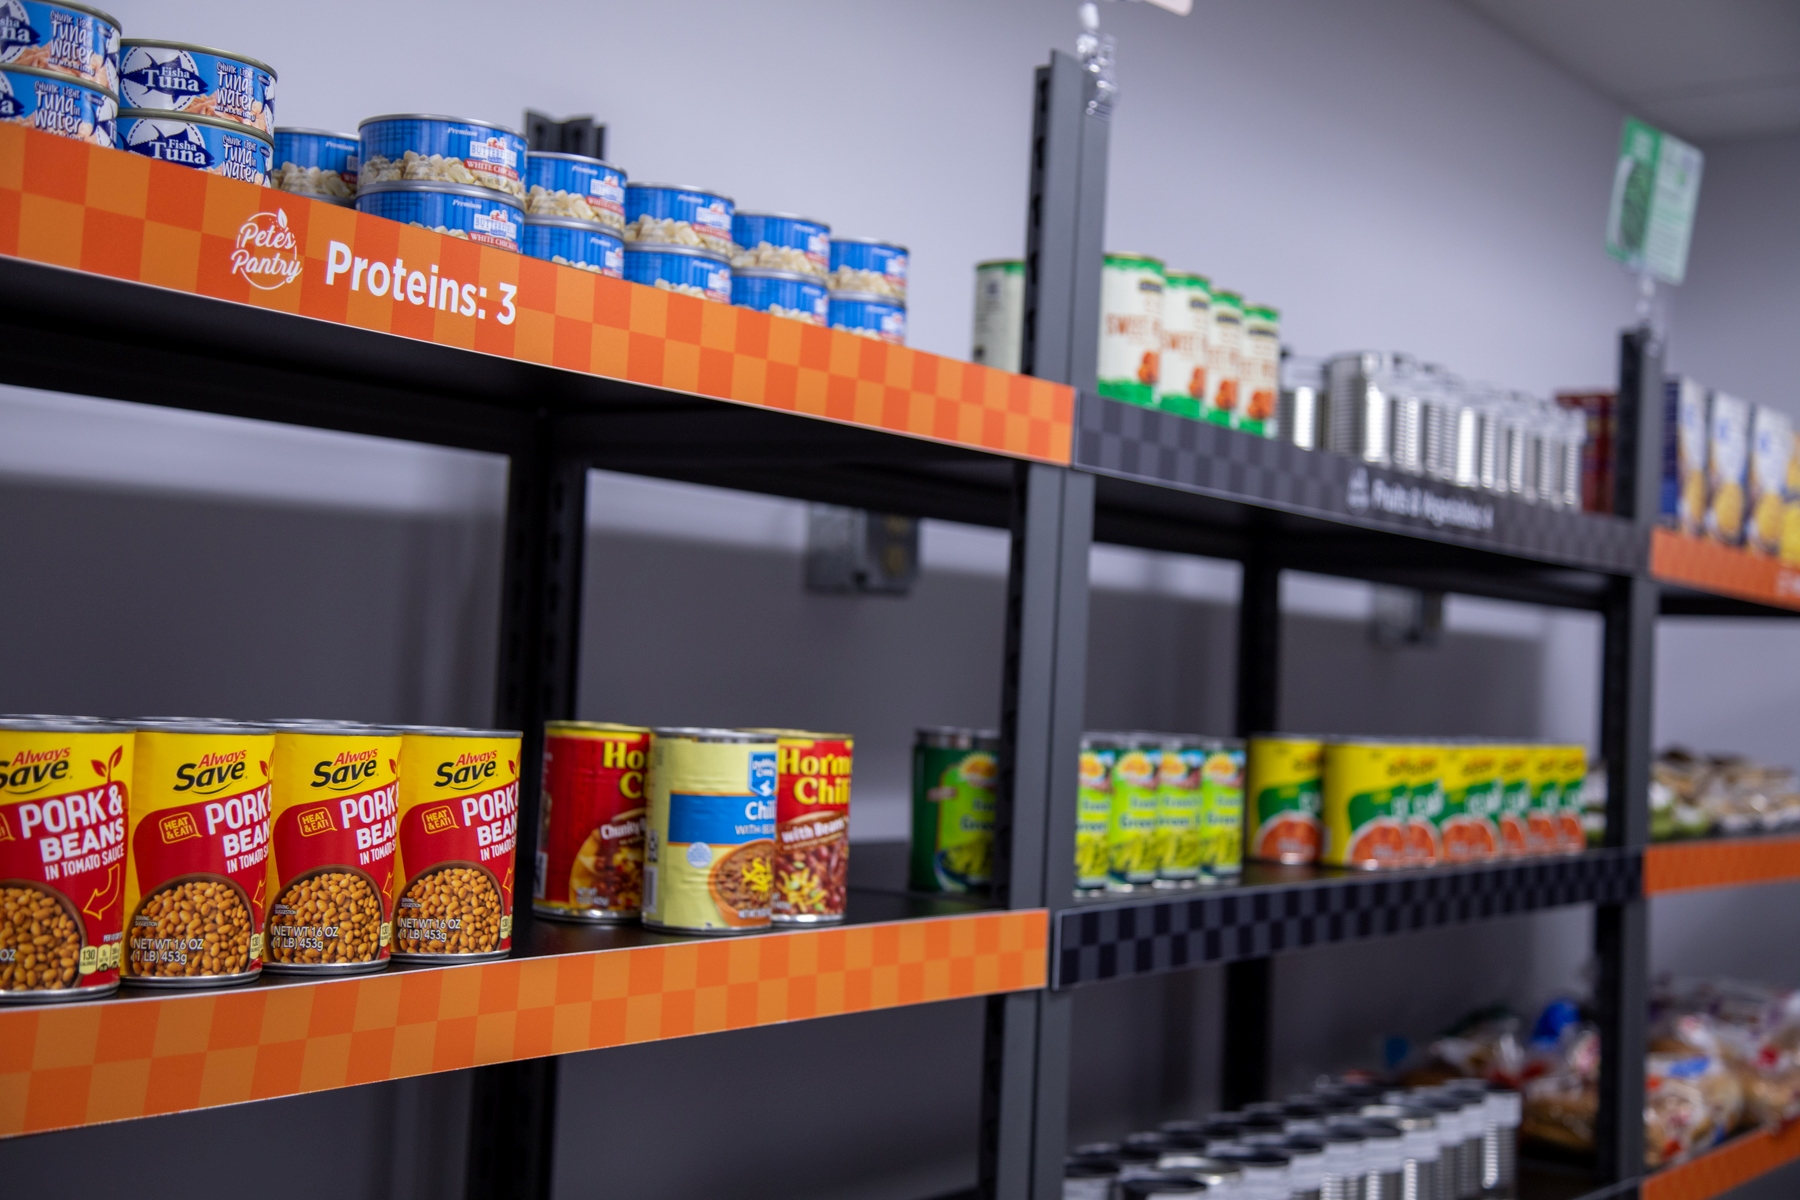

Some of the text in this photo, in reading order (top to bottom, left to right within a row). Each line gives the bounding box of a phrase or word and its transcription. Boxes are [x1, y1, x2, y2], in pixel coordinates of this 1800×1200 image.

[0, 16, 20, 28] sha
[0, 26, 30, 43] na
[51, 20, 87, 45] Tuna
[51, 39, 94, 65] Water
[142, 69, 200, 92] Tuna
[161, 66, 190, 79] Fisha
[217, 70, 249, 94] Tuna
[36, 89, 74, 115] Tuna
[216, 88, 254, 111] Water
[35, 109, 82, 134] Water
[447, 126, 478, 137] Premium
[149, 141, 206, 165] Tuna
[168, 138, 197, 151] Fisha
[223, 143, 252, 166] Tuna
[325, 140, 355, 151] Premium
[222, 160, 257, 182] Water
[466, 160, 493, 171] WHITE
[452, 199, 482, 210] Premium
[240, 222, 296, 249] Pete's
[470, 232, 494, 243] WHITE
[231, 249, 303, 284] Pantry
[326, 240, 518, 325] Proteins: 3
[11, 747, 71, 767] Always
[198, 749, 247, 769] Always
[333, 748, 378, 766] Always
[455, 750, 498, 767] Always
[779, 747, 851, 776] Horm
[0, 759, 69, 789] Save
[172, 761, 246, 791] Save
[310, 760, 377, 788] Save
[433, 760, 496, 787] Save
[793, 776, 850, 806] Chil
[18, 789, 107, 840] PORK
[108, 784, 124, 816] &
[204, 788, 267, 836] PORK
[340, 784, 395, 829] PORK
[461, 784, 515, 827] PORK
[744, 800, 776, 821] Chil
[163, 816, 189, 831] HEAT
[301, 811, 325, 825] HEAT
[304, 818, 330, 833] & EAT!
[425, 810, 447, 823] HEAT
[427, 817, 452, 831] & EAT!
[166, 823, 194, 840] & EAT!
[222, 818, 270, 858] BEAN
[356, 813, 398, 850] BEAN
[477, 812, 517, 847] BEAN
[601, 822, 640, 840] Chunky
[735, 823, 761, 836] WITH
[781, 824, 815, 843] with
[814, 819, 845, 838] Beans
[39, 817, 125, 863] BEANS
[44, 842, 125, 881] IN TOMATO SAUCE
[226, 858, 238, 874] IN
[238, 848, 264, 870] TOMATO
[359, 851, 370, 866] IN
[480, 847, 490, 862] IN
[273, 925, 339, 938] NET WT 16 OZ
[400, 918, 462, 929] NET WT 16 OZ
[132, 938, 204, 950] NET WT 16 OZ
[271, 938, 324, 951] (1 LB) 453g
[398, 929, 447, 942] (1 LB) 453g
[0, 948, 16, 962] OZ
[82, 949, 96, 961] 130
[131, 951, 140, 963] (1
[143, 951, 160, 963] LB)
[161, 951, 187, 965] 453g
